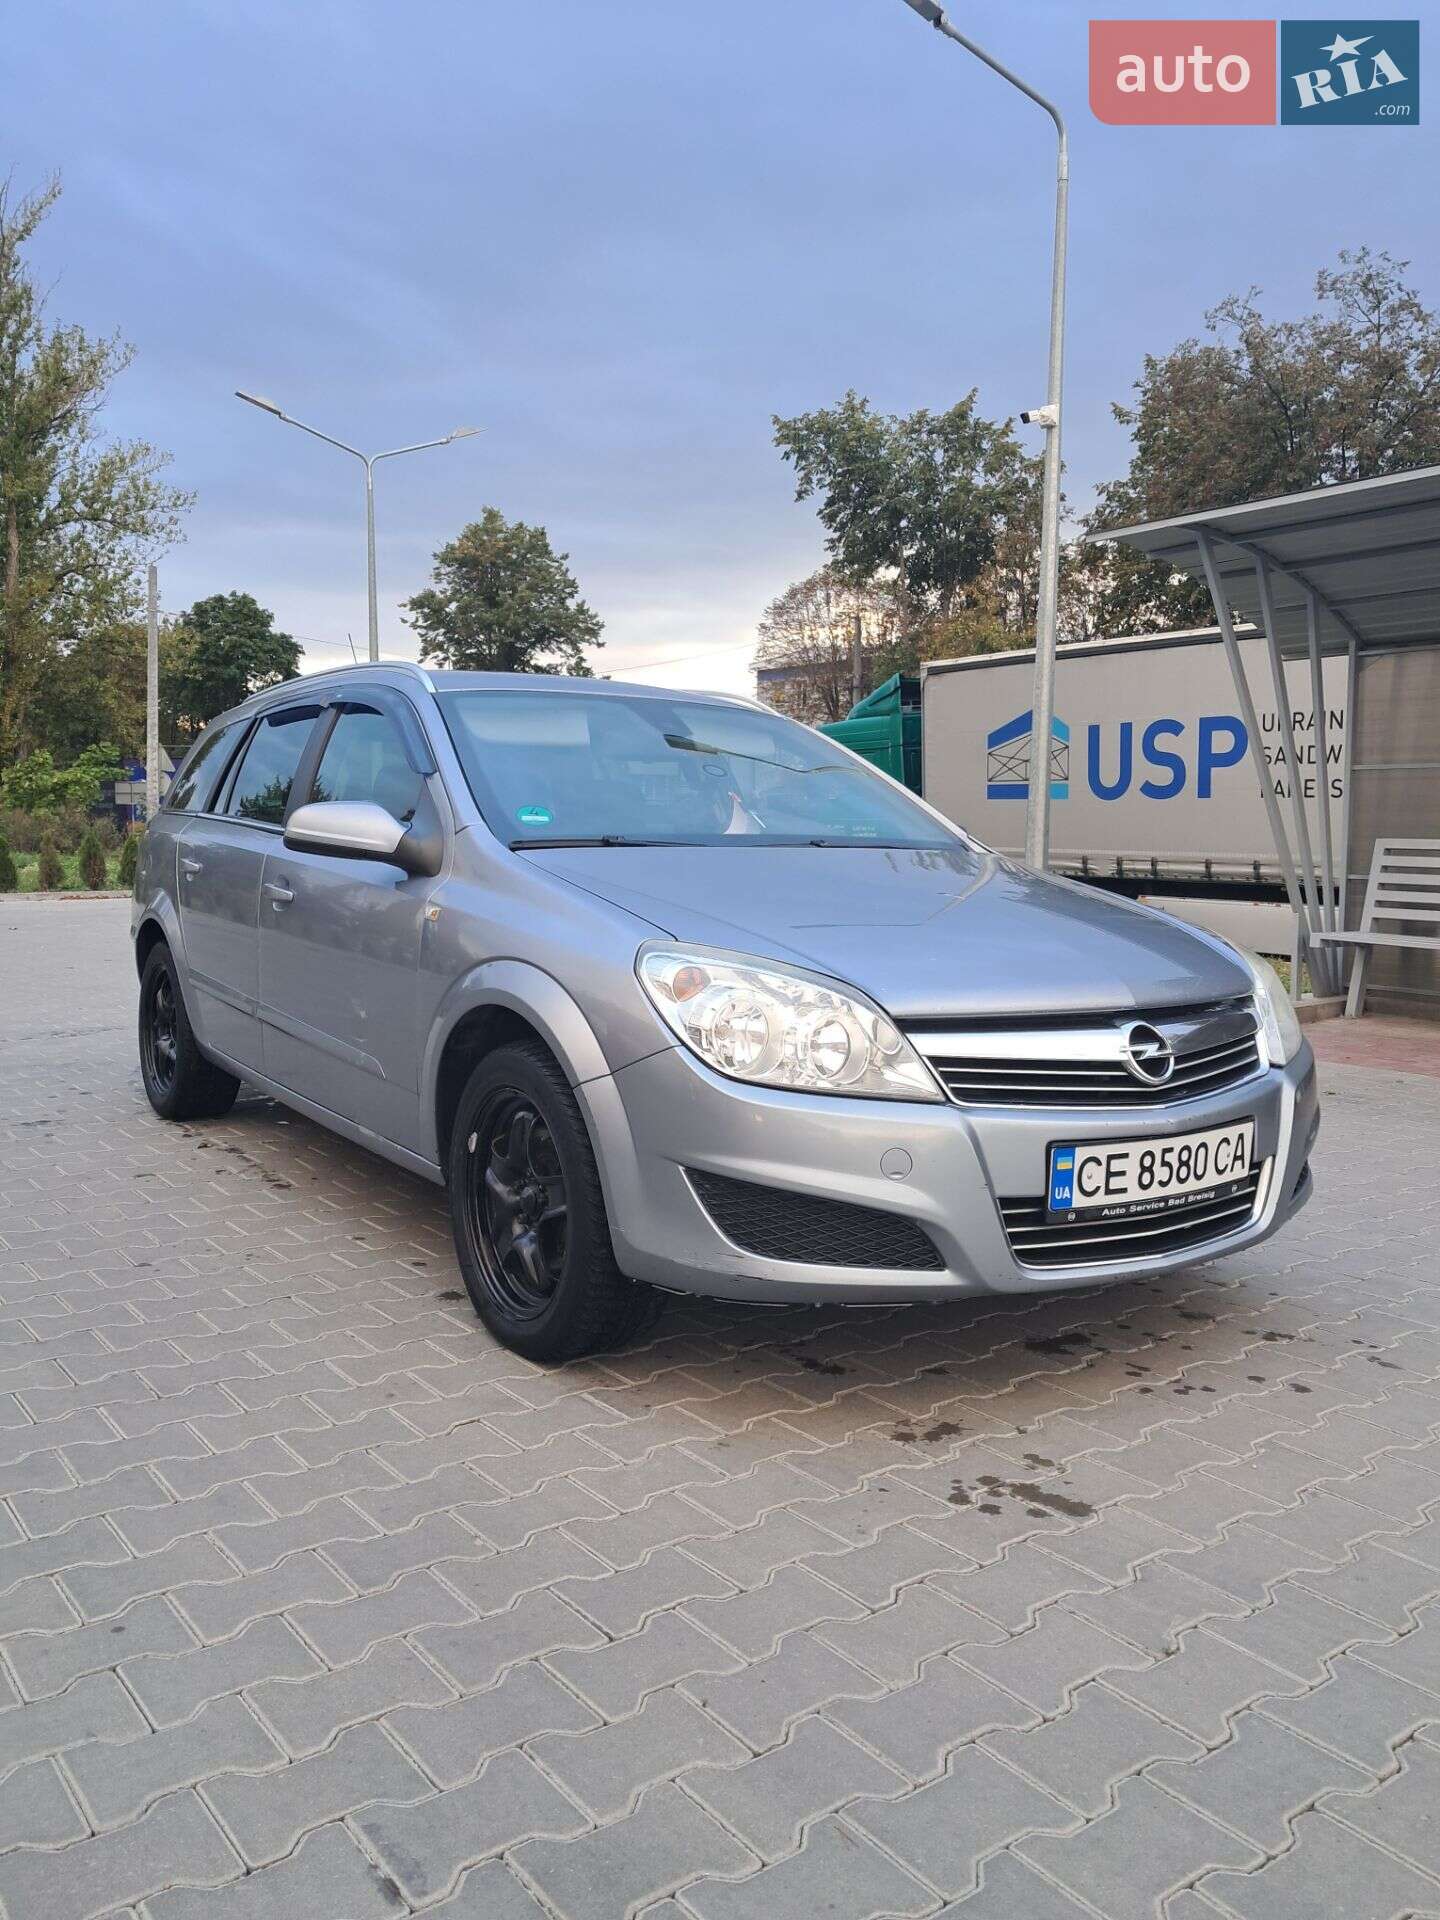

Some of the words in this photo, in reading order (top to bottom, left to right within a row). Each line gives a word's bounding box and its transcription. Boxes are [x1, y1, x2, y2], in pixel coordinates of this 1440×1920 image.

[1087, 714, 1249, 801] USP
[1055, 1186, 1071, 1200] UA
[1077, 1152, 1130, 1198] CE
[1137, 1141, 1208, 1191] 8580
[1214, 1132, 1246, 1176] CA
[1101, 1208, 1126, 1216] Auto
[1129, 1202, 1165, 1212] Service
[1168, 1197, 1185, 1206] Bad
